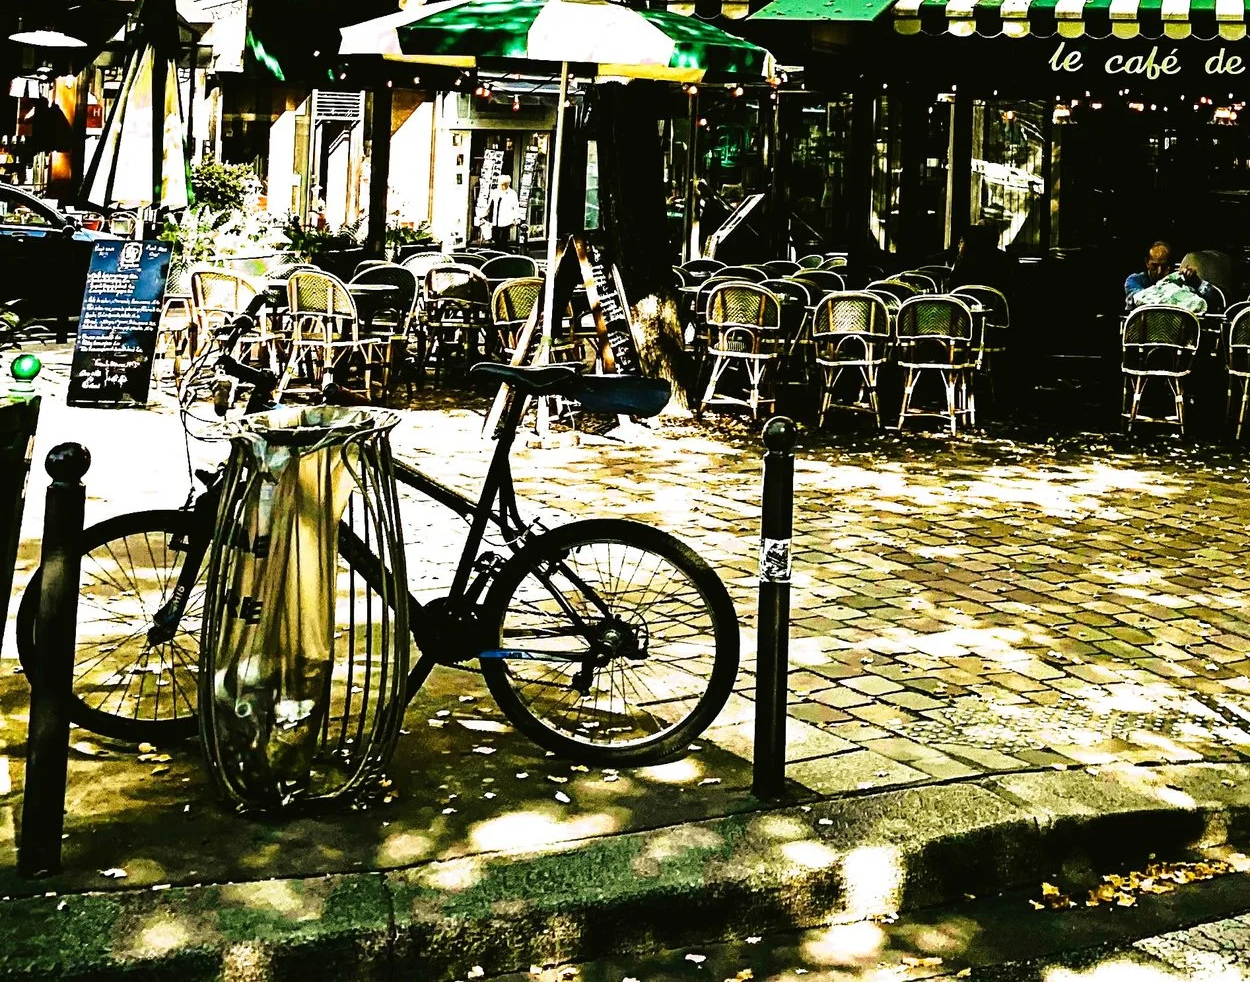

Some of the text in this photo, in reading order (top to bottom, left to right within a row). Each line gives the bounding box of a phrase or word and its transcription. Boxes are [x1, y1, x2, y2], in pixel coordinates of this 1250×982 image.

[1048, 41, 1084, 73] le
[1104, 45, 1182, 80] café
[1205, 47, 1246, 75] de
